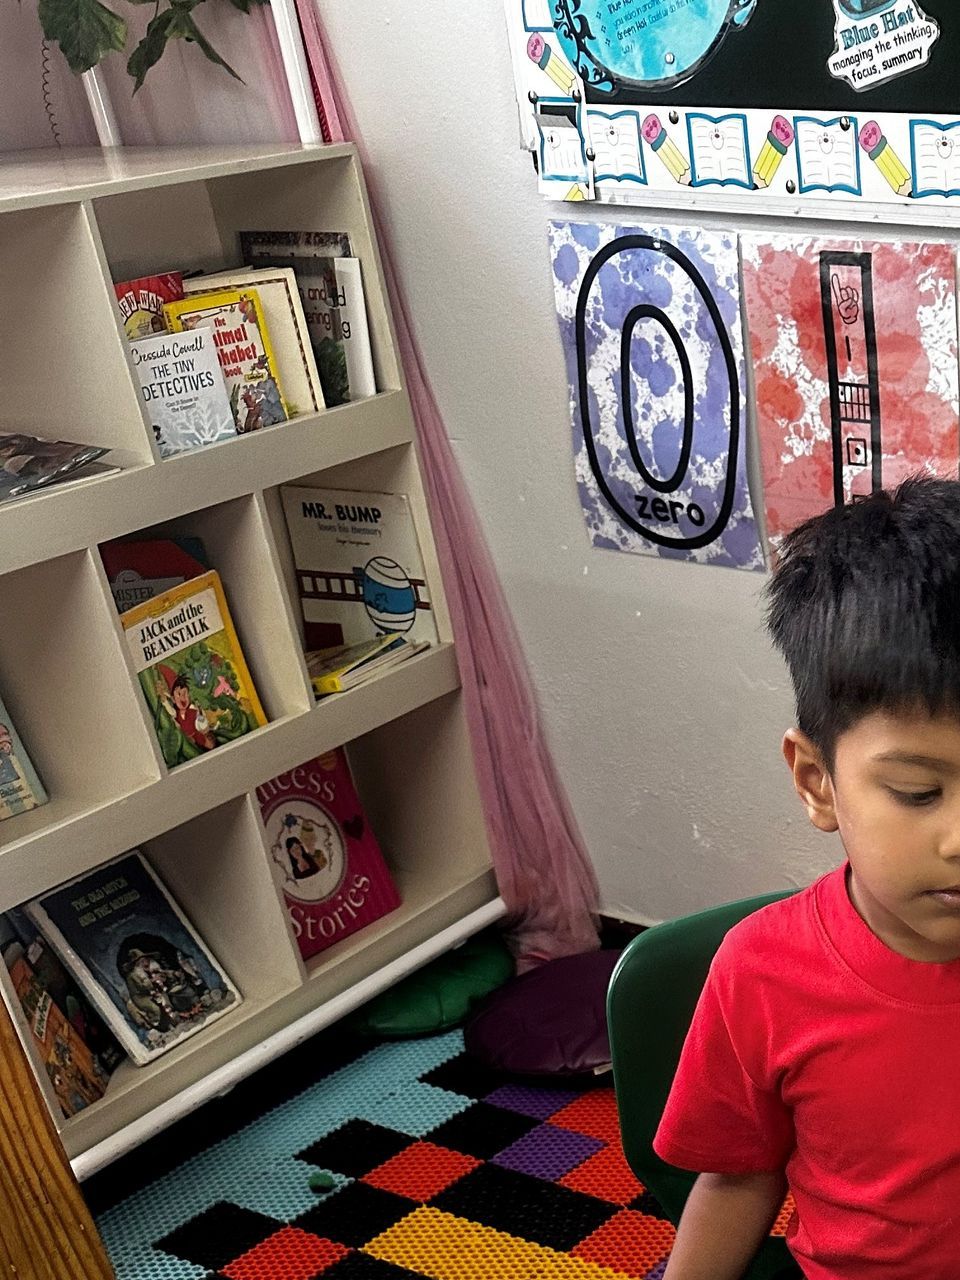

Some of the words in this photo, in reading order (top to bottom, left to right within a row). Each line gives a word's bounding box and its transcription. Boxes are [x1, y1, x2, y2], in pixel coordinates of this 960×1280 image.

[840, 23, 880, 50] Blue
[880, 4, 915, 34] Hat
[832, 48, 874, 71] managing
[875, 40, 892, 54] the
[893, 24, 936, 48] thinking,
[851, 64, 881, 82] focus,
[881, 46, 923, 71] summary
[131, 343, 171, 366] Cressida
[172, 335, 206, 358] Cowell
[212, 323, 248, 347] imal
[151, 363, 172, 379] THE
[172, 358, 196, 375] TINY
[217, 342, 258, 367] habet
[141, 370, 215, 402] DETECTIVES
[224, 366, 243, 378] book
[576, 234, 740, 550] 0
[302, 502, 333, 520] MR.
[335, 504, 382, 523] BUMP
[633, 494, 707, 527] zero
[140, 618, 167, 644] JACK
[167, 610, 187, 630] and
[186, 603, 204, 620] the
[143, 617, 210, 662] BEANSTALK
[259, 767, 336, 802] ncess
[287, 874, 371, 940] Stories
